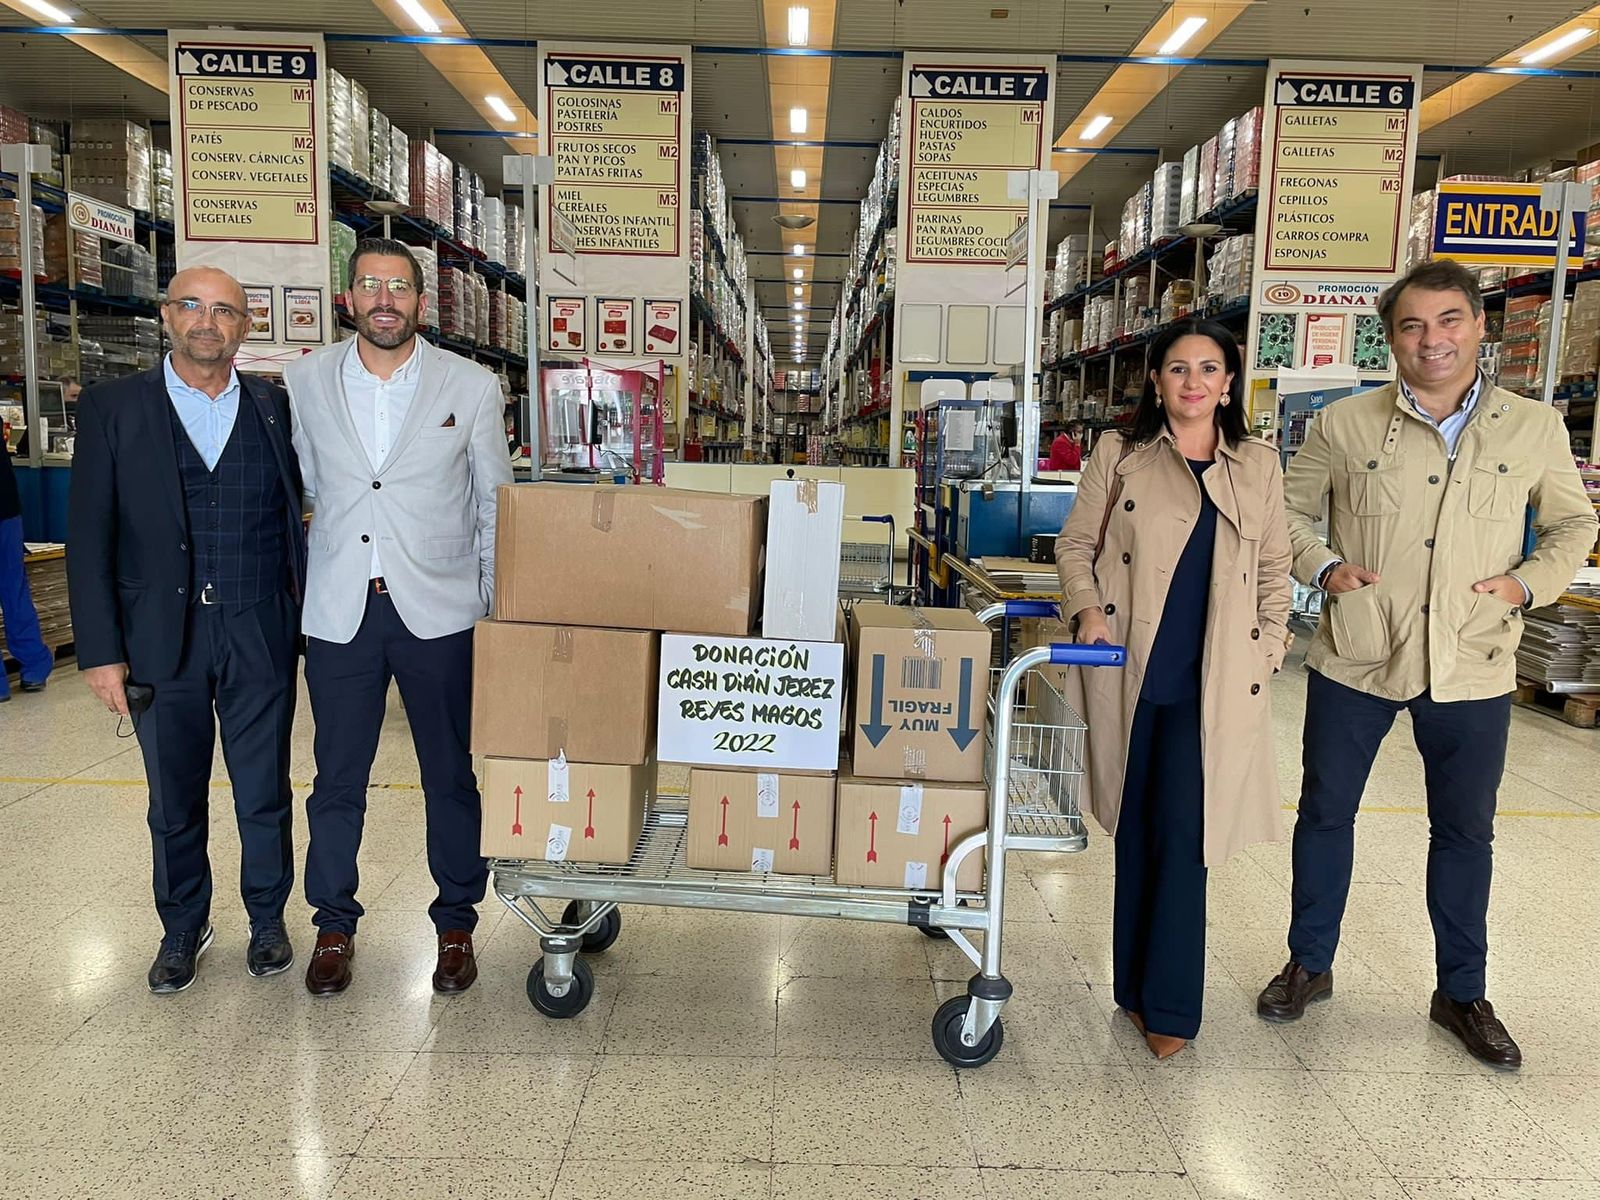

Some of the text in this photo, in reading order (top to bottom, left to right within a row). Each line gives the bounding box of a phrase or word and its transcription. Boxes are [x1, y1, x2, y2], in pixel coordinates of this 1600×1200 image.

[201, 53, 306, 75] CALLE 9
[570, 65, 673, 86] CALLE 8
[934, 76, 1037, 95] CALLE 7
[189, 86, 254, 97] CONSERVAS
[294, 89, 311, 100] M1
[1300, 84, 1403, 104] CALLE 6
[189, 101, 258, 111] DE PESCADO
[557, 97, 622, 108] GOLOSINAS
[661, 101, 678, 112] M1
[557, 108, 618, 120] PASTELERÍA
[920, 108, 962, 117] CALDOS
[1023, 111, 1040, 122] M1
[920, 120, 987, 129] ENCURTIDOS
[1285, 116, 1337, 126] GALLETAS
[1388, 118, 1405, 130] M1
[558, 122, 603, 132] POSTRES
[191, 131, 222, 144] PATÉS
[920, 131, 962, 140] HUEVOS
[295, 138, 313, 149] M2
[558, 143, 636, 154] FRUTOS SECOS
[919, 142, 956, 151] PASTAS
[660, 146, 678, 157] M2
[1282, 147, 1335, 157] GALLETAS
[1385, 149, 1403, 160] M2
[191, 152, 304, 164] CONSERV. CÁRNICAS
[558, 155, 625, 165] PAN Y PICOS
[919, 153, 951, 162] SOPAS
[192, 171, 308, 182] CONSERV. VEGETALES
[558, 167, 642, 178] PATATAS FRITAS
[918, 171, 977, 181] ACEITUNAS
[918, 182, 964, 191] ESPECIAS
[1280, 178, 1338, 188] FREGONAS
[1382, 180, 1400, 191] M3
[557, 191, 582, 200] MIEL
[659, 194, 677, 205] M3
[918, 193, 979, 202] LEGUMBRES
[1279, 196, 1328, 206] CEPILLOS
[193, 199, 258, 209] CONSERVAS
[297, 202, 315, 213] M3
[558, 202, 607, 212] CEREALES
[194, 214, 252, 224] VEGETALES
[564, 214, 674, 226] IMENTOS INFANTIL.
[917, 214, 962, 223] HARINAS
[1278, 210, 1335, 223] PLÁSTICOS
[91, 217, 122, 235] DIANA
[574, 226, 658, 237] NSERVAS FRUTA
[916, 225, 983, 235] PAN RAYADO
[916, 237, 975, 246] LEGUMBRES
[1276, 231, 1369, 242] CARROS COMPRA
[577, 238, 659, 248] HES INFANTILES
[915, 247, 1007, 257] PLATOS PRECOCIN
[1275, 249, 1327, 260] ESPONJAS
[1318, 284, 1379, 292] PROMOCIÓN
[1303, 295, 1366, 305] DIANA
[667, 668, 718, 691] CASH
[774, 675, 835, 699] JEREZ
[888, 700, 952, 714] FRAGIL
[679, 700, 823, 729] REYES MAGOS
[899, 719, 938, 731] MUY
[713, 732, 776, 753] 2022
